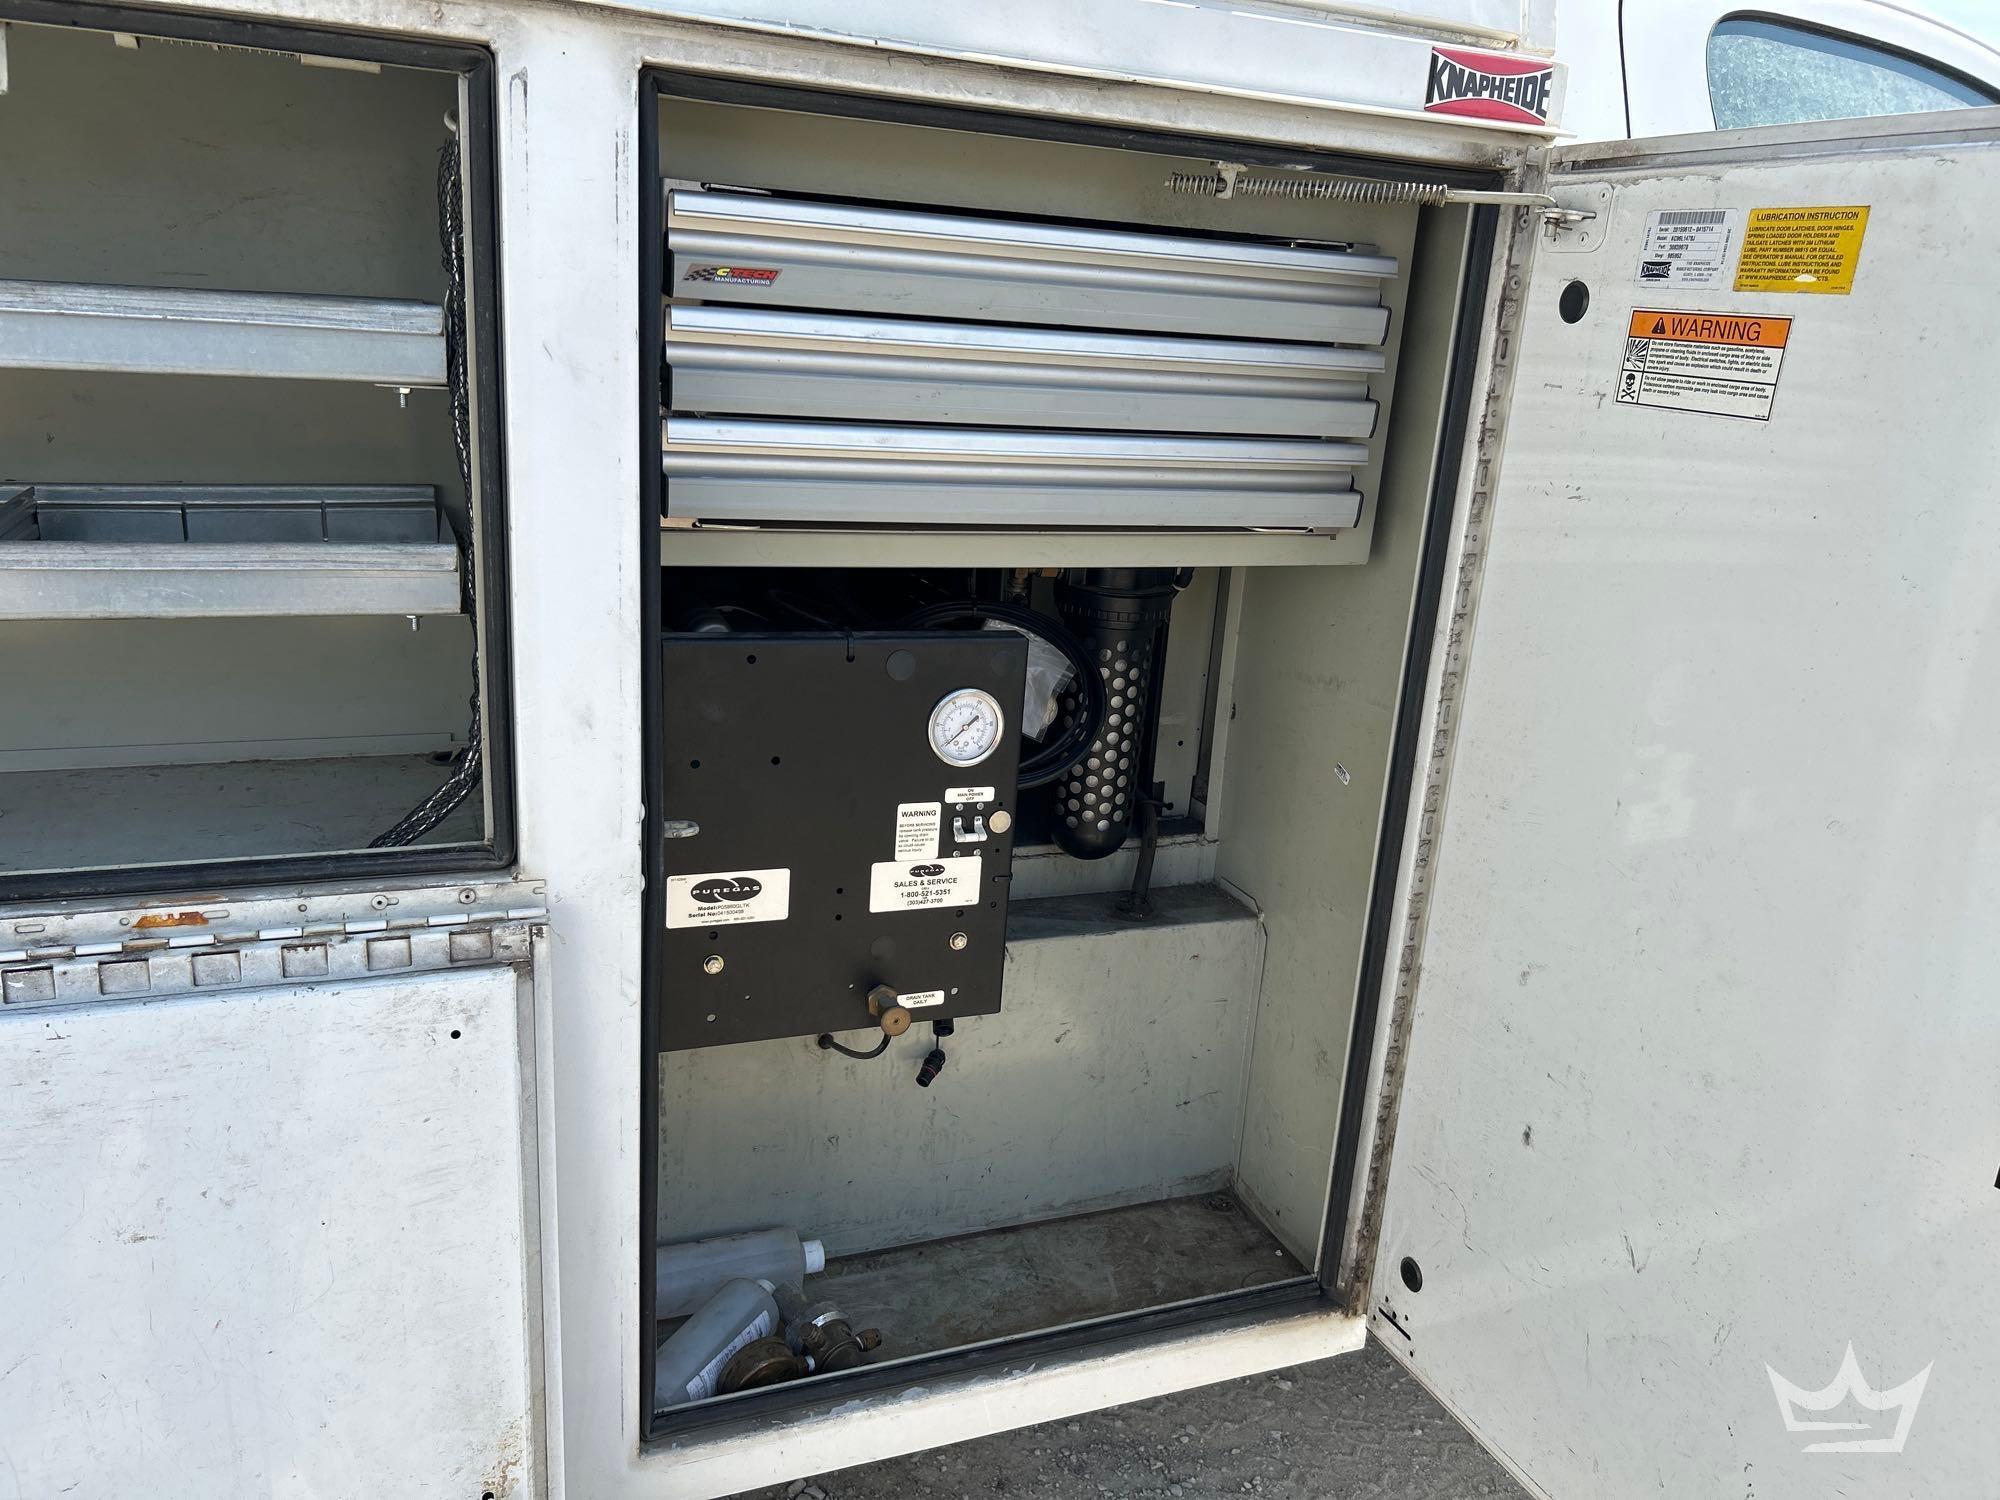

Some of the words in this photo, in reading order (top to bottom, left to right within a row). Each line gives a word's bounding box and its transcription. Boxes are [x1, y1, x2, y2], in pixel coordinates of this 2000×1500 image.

[1425, 52, 1552, 118] KNAPHEIDE
[1756, 213, 1805, 221] LUBRICATION
[1806, 212, 1860, 220] INSTRUCTION
[715, 276, 770, 285] MANUFACTURING
[1672, 317, 1761, 341] WARNING
[692, 886, 760, 895] PUREGAS
[901, 889, 951, 898] 1-800-521-5351
